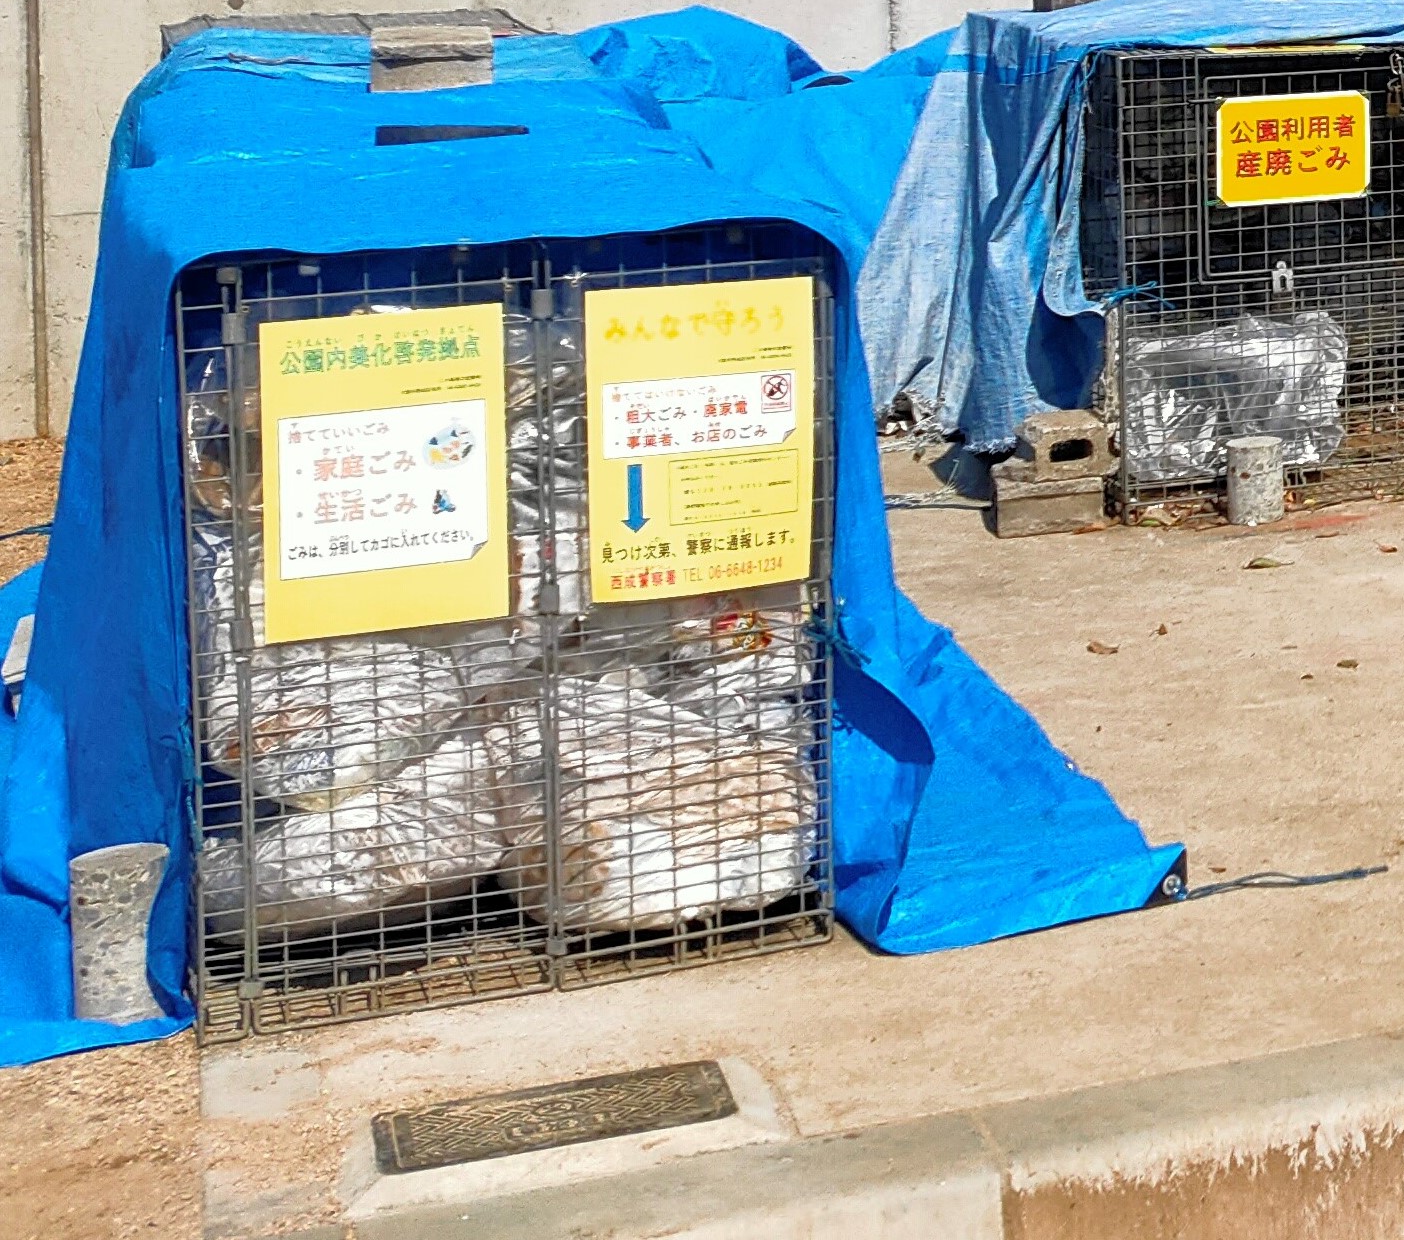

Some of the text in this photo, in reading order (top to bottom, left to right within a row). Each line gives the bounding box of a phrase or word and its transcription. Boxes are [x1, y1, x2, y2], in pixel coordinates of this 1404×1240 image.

[1230, 113, 1357, 144] 公園利用者
[1235, 145, 1351, 179] 産廃ごみ
[603, 305, 785, 344] みんなで守ろう
[279, 334, 481, 376] 公園内美化啓発拠点
[288, 529, 475, 561] ごみは、分別してカゴに入れてください。
[601, 528, 796, 564] 見つけ次第、警察に通報します。
[683, 568, 703, 583] TEL
[708, 556, 784, 580] 06-6648-1234
